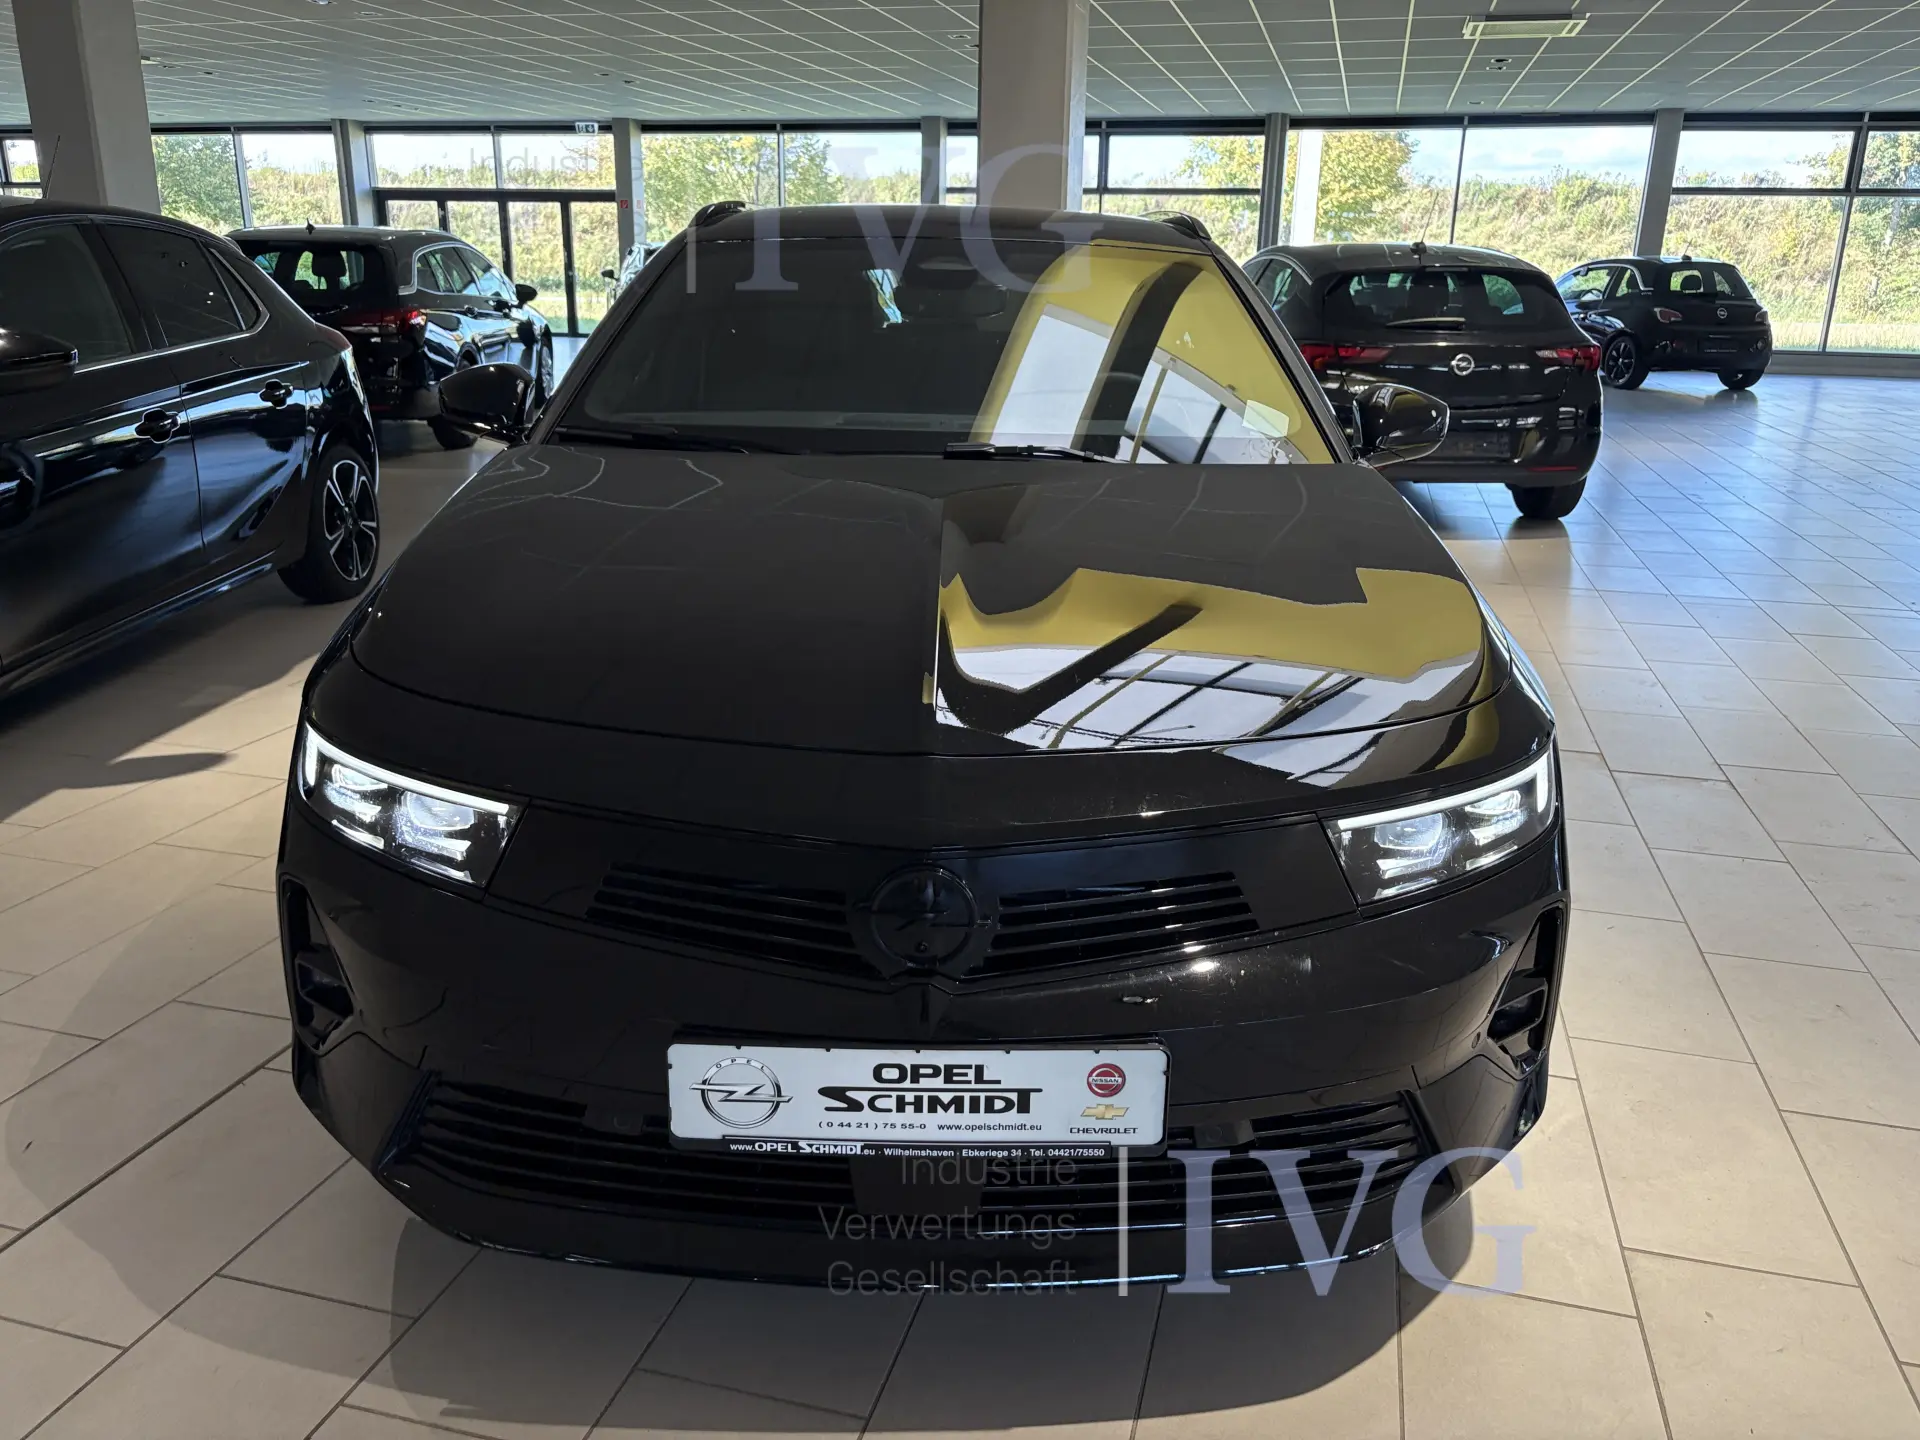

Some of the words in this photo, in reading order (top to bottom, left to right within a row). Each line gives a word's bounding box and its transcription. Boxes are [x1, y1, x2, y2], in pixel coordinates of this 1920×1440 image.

[715, 1057, 766, 1072] OPEL
[873, 1063, 1002, 1085] OPEL
[817, 1086, 1043, 1114] SCHMIDT
[937, 1121, 1042, 1133] www.opelschmidt.eu
[884, 1147, 954, 1157] Wilhelmshaven
[962, 1149, 1008, 1158] Ebkeriege
[1010, 1149, 1021, 1157] 34
[1030, 1148, 1046, 1157] Tel.
[1048, 1148, 1105, 1157] 04421/75550
